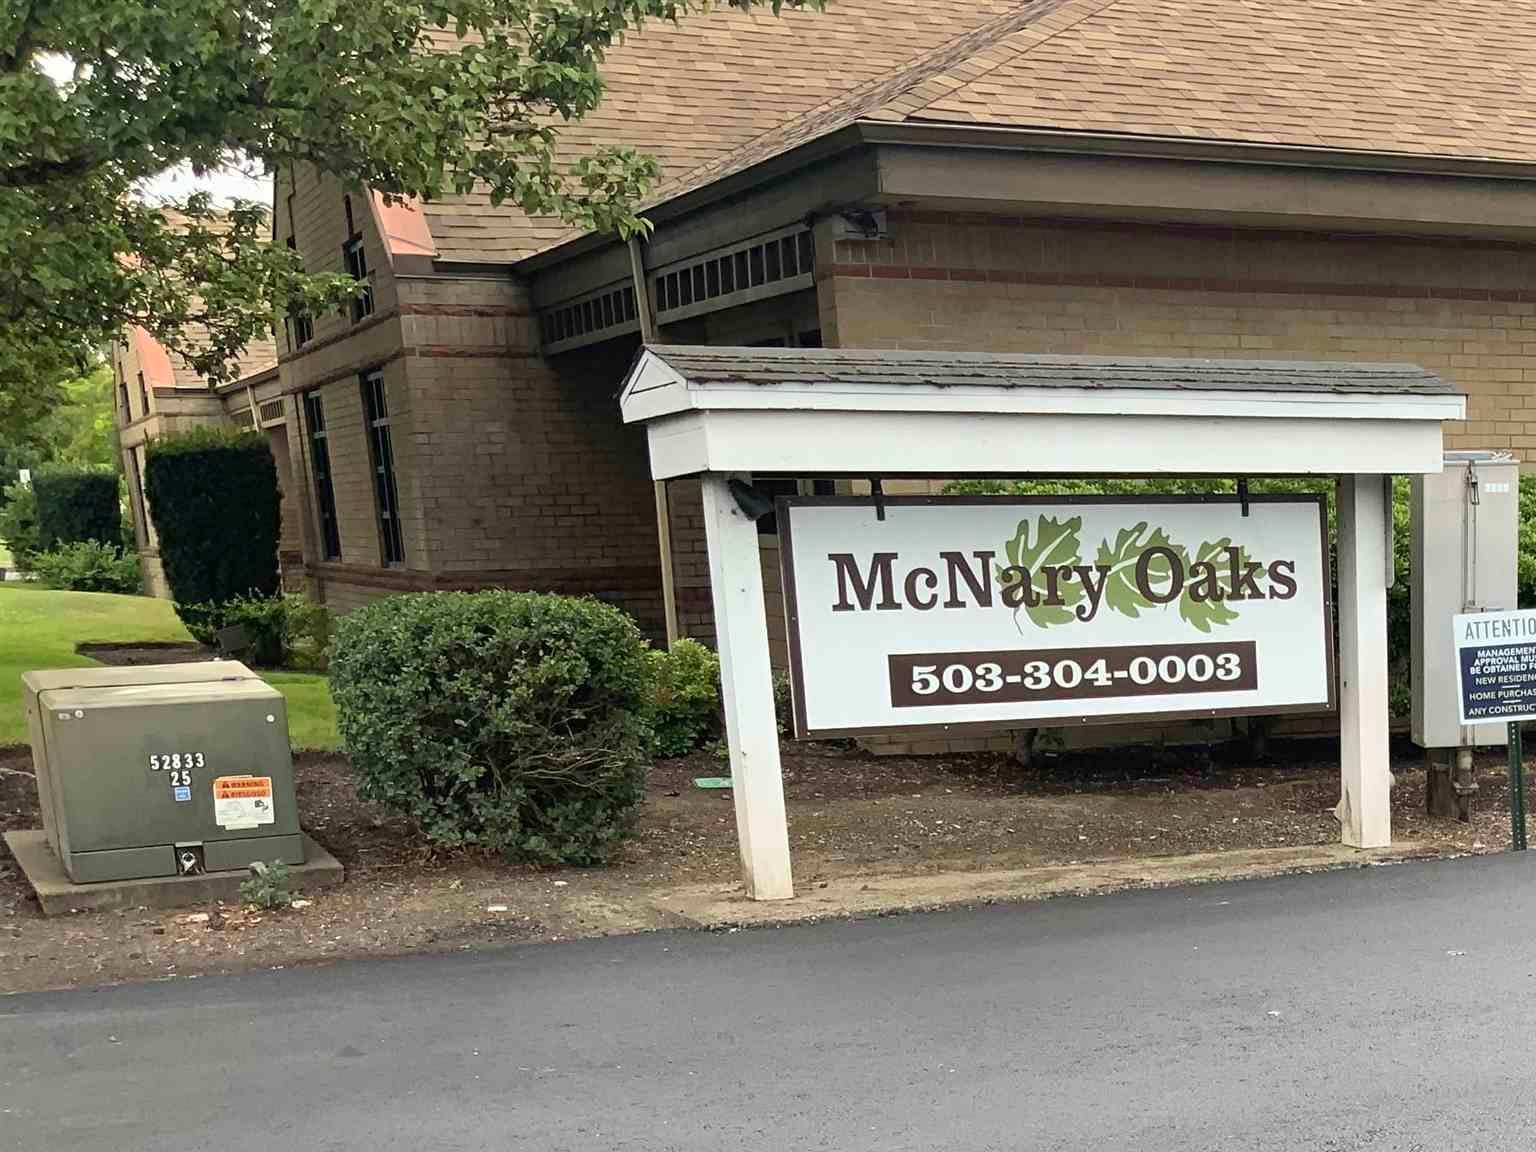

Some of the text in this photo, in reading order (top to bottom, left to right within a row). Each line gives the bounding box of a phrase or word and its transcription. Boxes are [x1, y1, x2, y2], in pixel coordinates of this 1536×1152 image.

[827, 545, 1298, 622] McNary Oaks
[1474, 656, 1519, 666] APPROVAL
[910, 653, 1242, 696] 503-304-0003
[1470, 666, 1481, 675] BE
[1483, 663, 1527, 674] OBTAINED
[1475, 676, 1496, 685] NEW
[1469, 691, 1496, 700] HOME
[1468, 706, 1487, 715] ANY
[150, 752, 205, 770] 52833
[170, 770, 192, 786] 25
